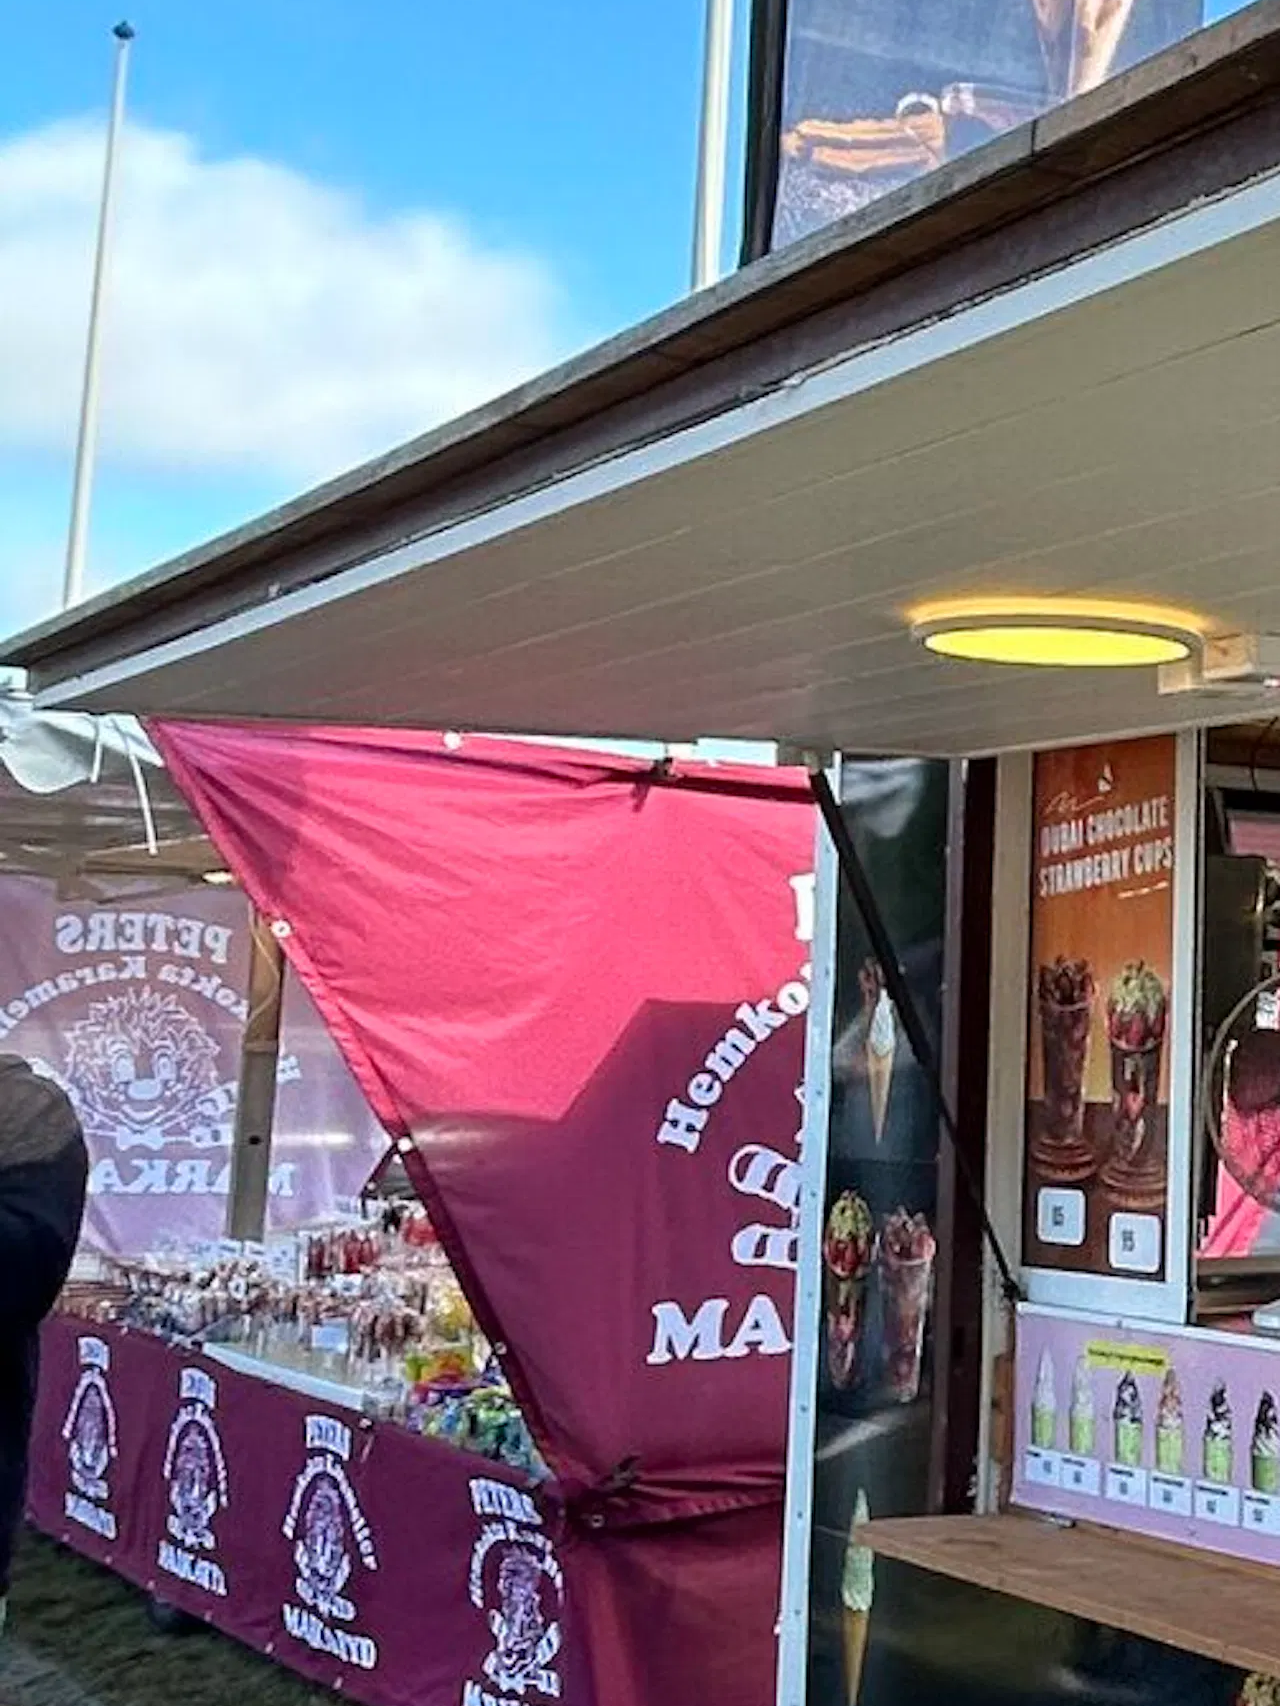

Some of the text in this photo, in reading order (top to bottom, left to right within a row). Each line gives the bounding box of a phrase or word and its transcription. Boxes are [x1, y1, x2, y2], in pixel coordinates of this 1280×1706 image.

[1086, 795, 1170, 846] CHOCOLATE
[1133, 836, 1174, 875] CUPS
[656, 963, 814, 1154] Hemko
